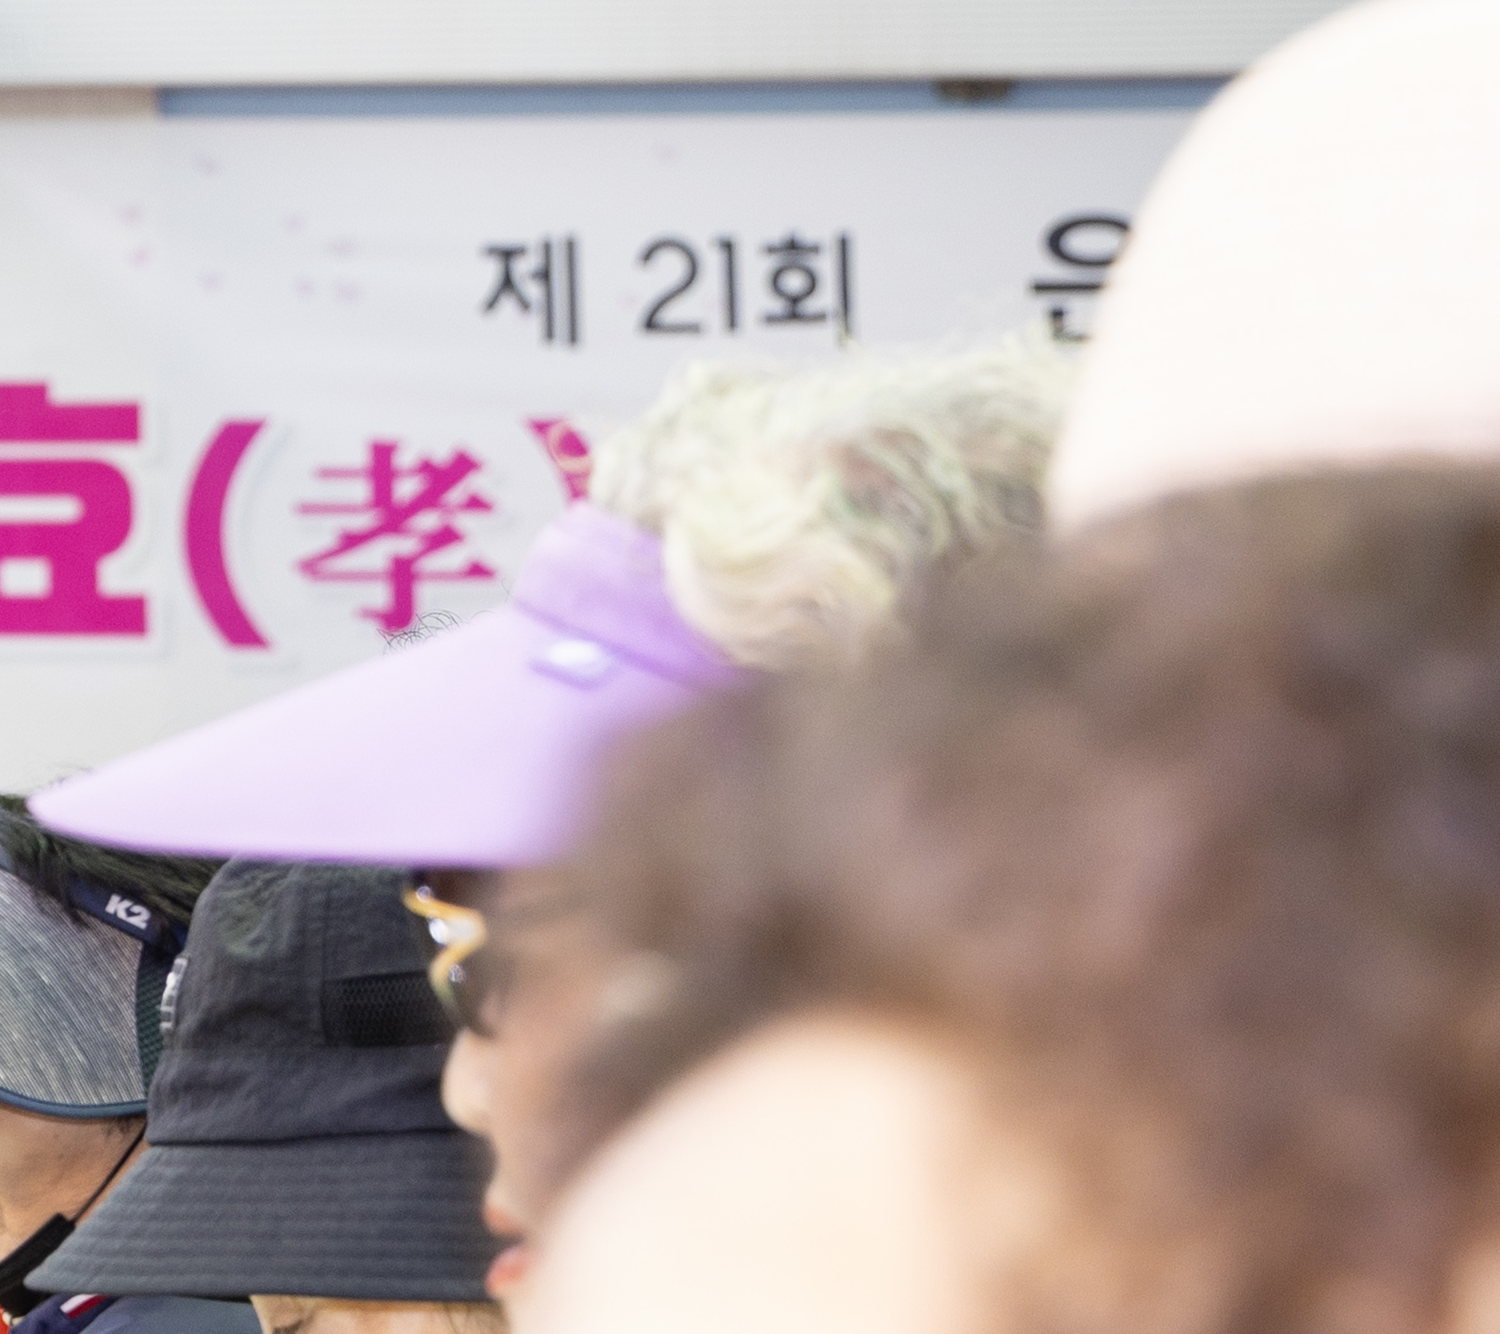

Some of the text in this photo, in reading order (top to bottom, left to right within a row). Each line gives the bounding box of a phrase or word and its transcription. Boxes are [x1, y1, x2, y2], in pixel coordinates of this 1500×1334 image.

[483, 235, 581, 349] 제
[638, 233, 856, 341] 21회
[104, 893, 151, 930] K2
